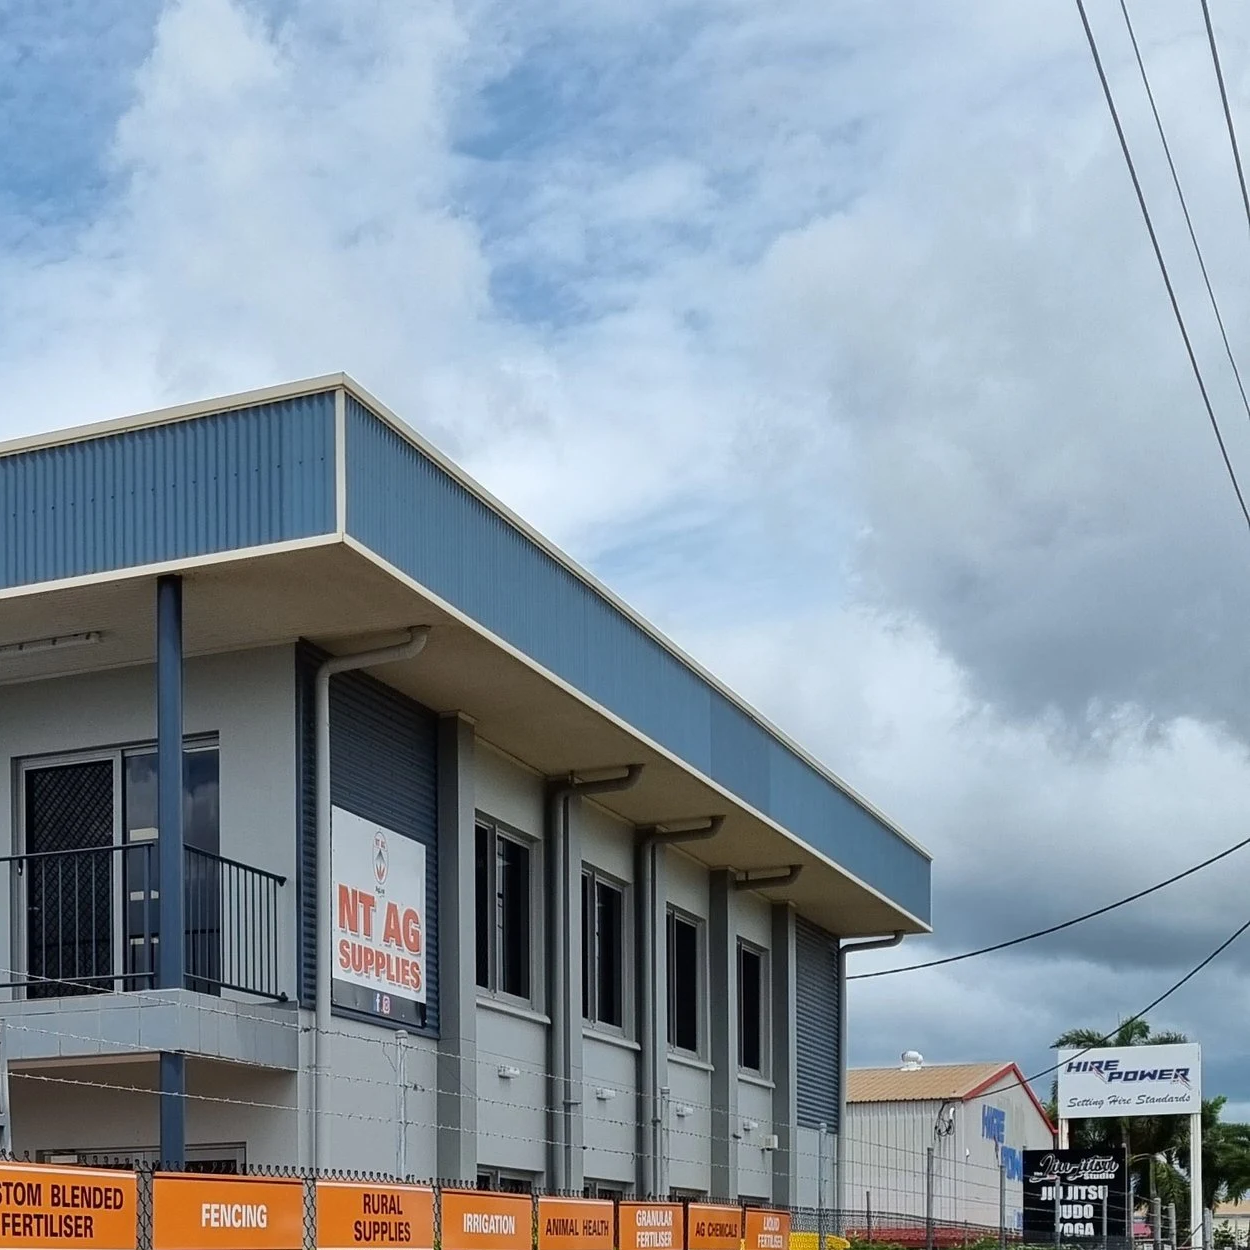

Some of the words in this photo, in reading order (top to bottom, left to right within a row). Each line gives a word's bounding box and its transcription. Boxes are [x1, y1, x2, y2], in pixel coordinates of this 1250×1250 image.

[338, 883, 375, 938] NT
[382, 901, 421, 955] AG
[339, 938, 421, 991] SUPPLIES
[1067, 1059, 1120, 1074] HIRE
[1107, 1067, 1191, 1083] POWER
[1067, 1097, 1105, 1109] Setting
[1107, 1094, 1131, 1105] Hire
[1135, 1093, 1191, 1105] Standards
[50, 1185, 124, 1211] BLENDED
[1066, 1185, 1109, 1201] JITSU
[362, 1193, 403, 1215] RURAL
[1059, 1204, 1094, 1219] UDO
[1, 1213, 94, 1239] FERTILISER
[200, 1203, 268, 1229] FENCING
[462, 1212, 515, 1236] IRRIGATION
[635, 1209, 673, 1227] GRANULAR
[353, 1220, 412, 1243] SUPPLIES
[545, 1217, 579, 1236] ANIMAL
[582, 1219, 609, 1237] HEALTH
[695, 1222, 705, 1237] AG
[707, 1222, 738, 1238] CHEMICALS
[636, 1231, 673, 1248] FERTILISER
